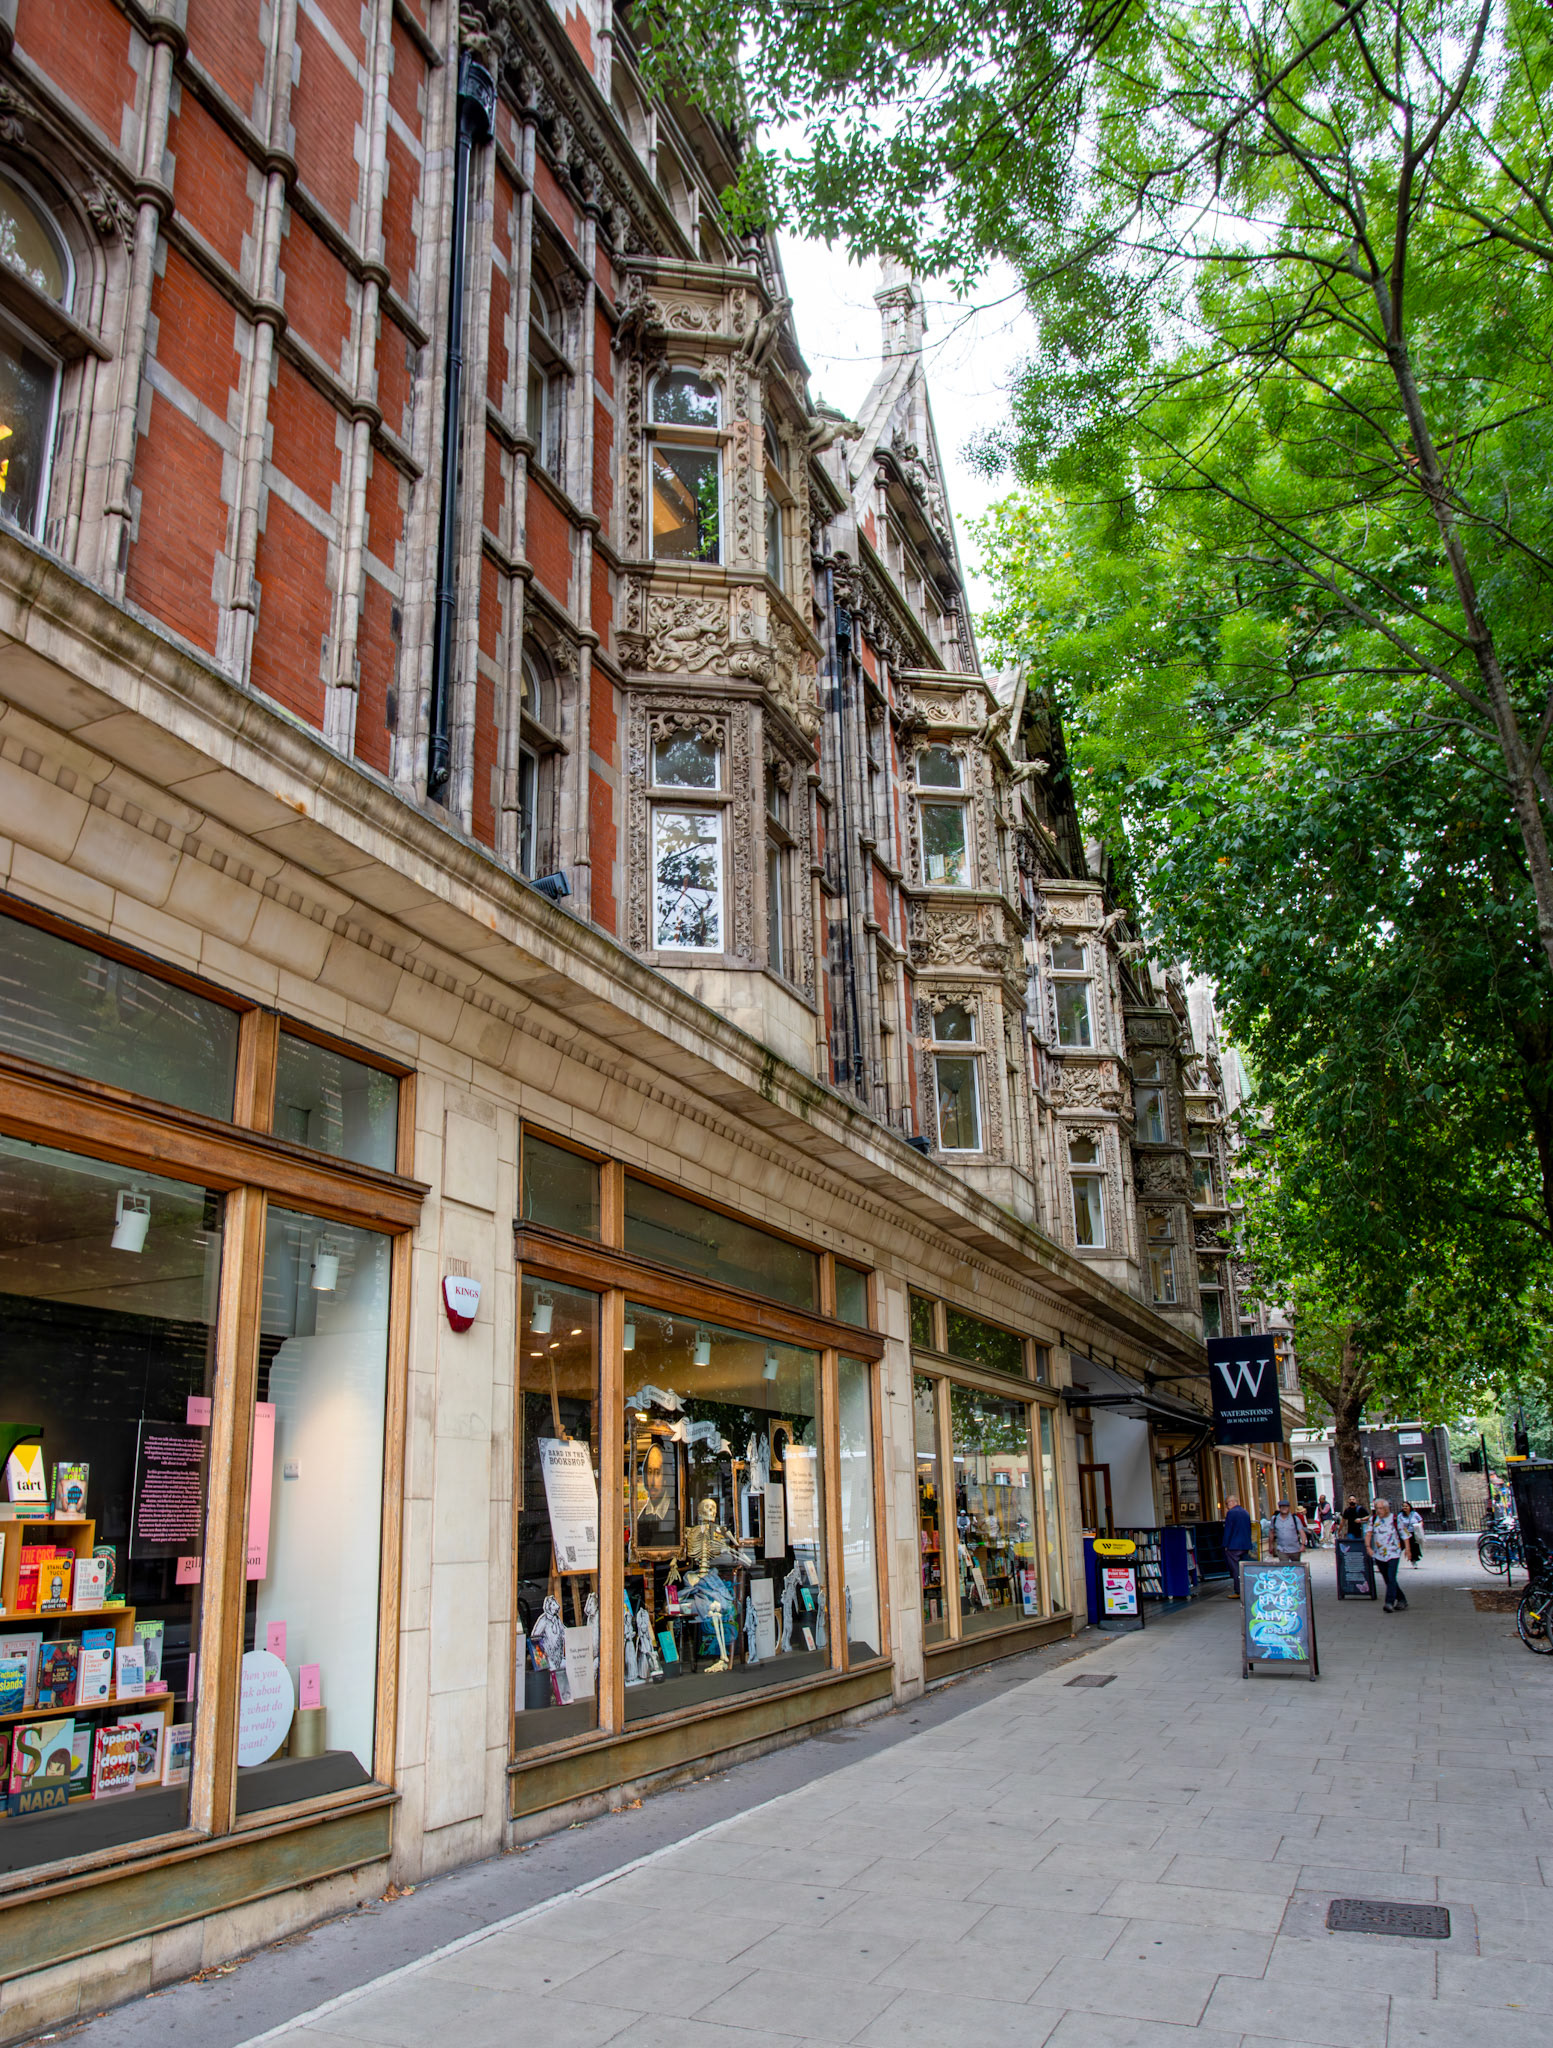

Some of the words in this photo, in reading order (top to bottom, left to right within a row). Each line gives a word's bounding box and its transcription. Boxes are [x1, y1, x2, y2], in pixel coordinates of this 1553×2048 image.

[455, 1285, 479, 1298] KINGS
[1213, 1359, 1270, 1399] W
[1220, 1408, 1274, 1417] WATERSTONES
[548, 1449, 564, 1457] BARD
[549, 1457, 585, 1466] BOOKSHOP
[17, 1480, 42, 1491] tart
[21, 1549, 35, 1564] THE
[35, 1548, 56, 1561] COST
[1263, 1581, 1274, 1590] IS
[1279, 1581, 1288, 1590] A
[1259, 1595, 1294, 1606] RIVER
[1255, 1611, 1298, 1621] ALIVE?
[261, 1670, 279, 1682] you
[0, 1677, 24, 1691] slands
[256, 1684, 281, 1696] about
[248, 1702, 270, 1715] what
[271, 1700, 283, 1712] do
[251, 1717, 277, 1732] really
[102, 1730, 138, 1747] upside
[240, 1735, 268, 1751] want?
[100, 1750, 137, 1768] down
[98, 1774, 135, 1789] cooking
[19, 1786, 67, 1813] NARA
